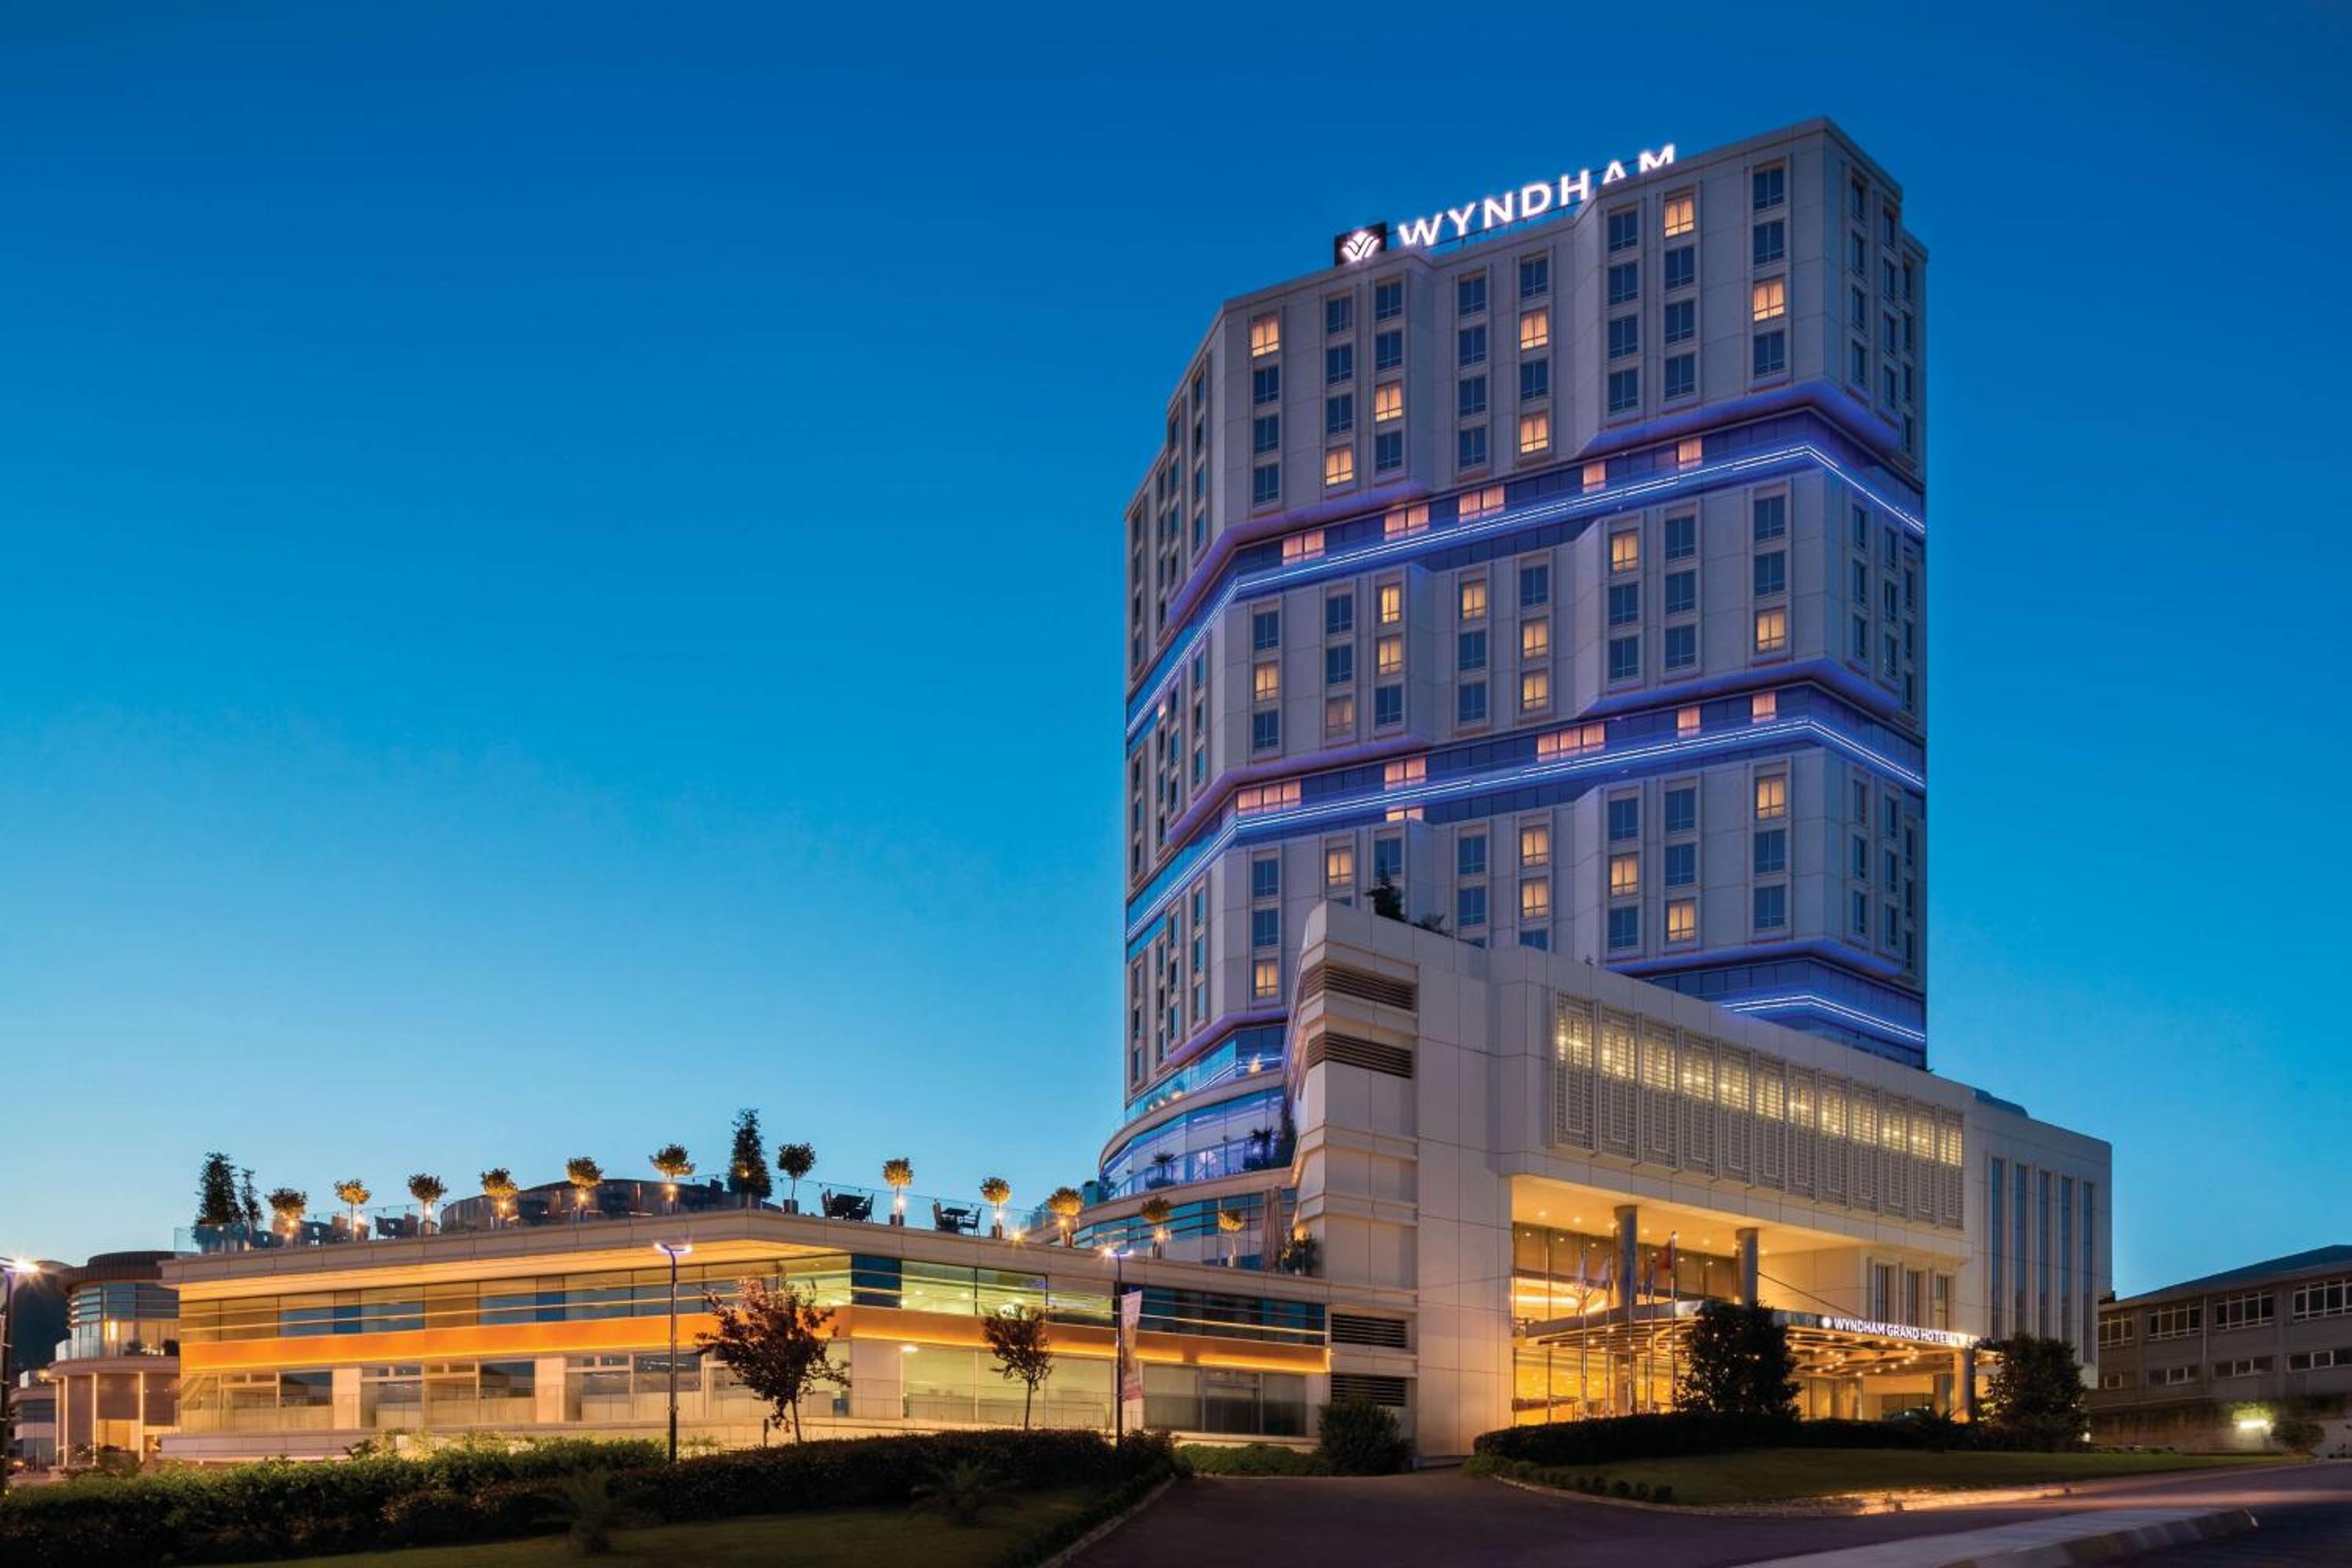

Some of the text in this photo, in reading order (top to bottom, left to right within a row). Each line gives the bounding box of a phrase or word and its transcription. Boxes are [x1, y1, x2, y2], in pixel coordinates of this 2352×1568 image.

[1398, 143, 1676, 248] WYNDHAM
[1833, 1317, 1885, 1335] WYNDHAM
[1886, 1324, 1919, 1340] GRAND
